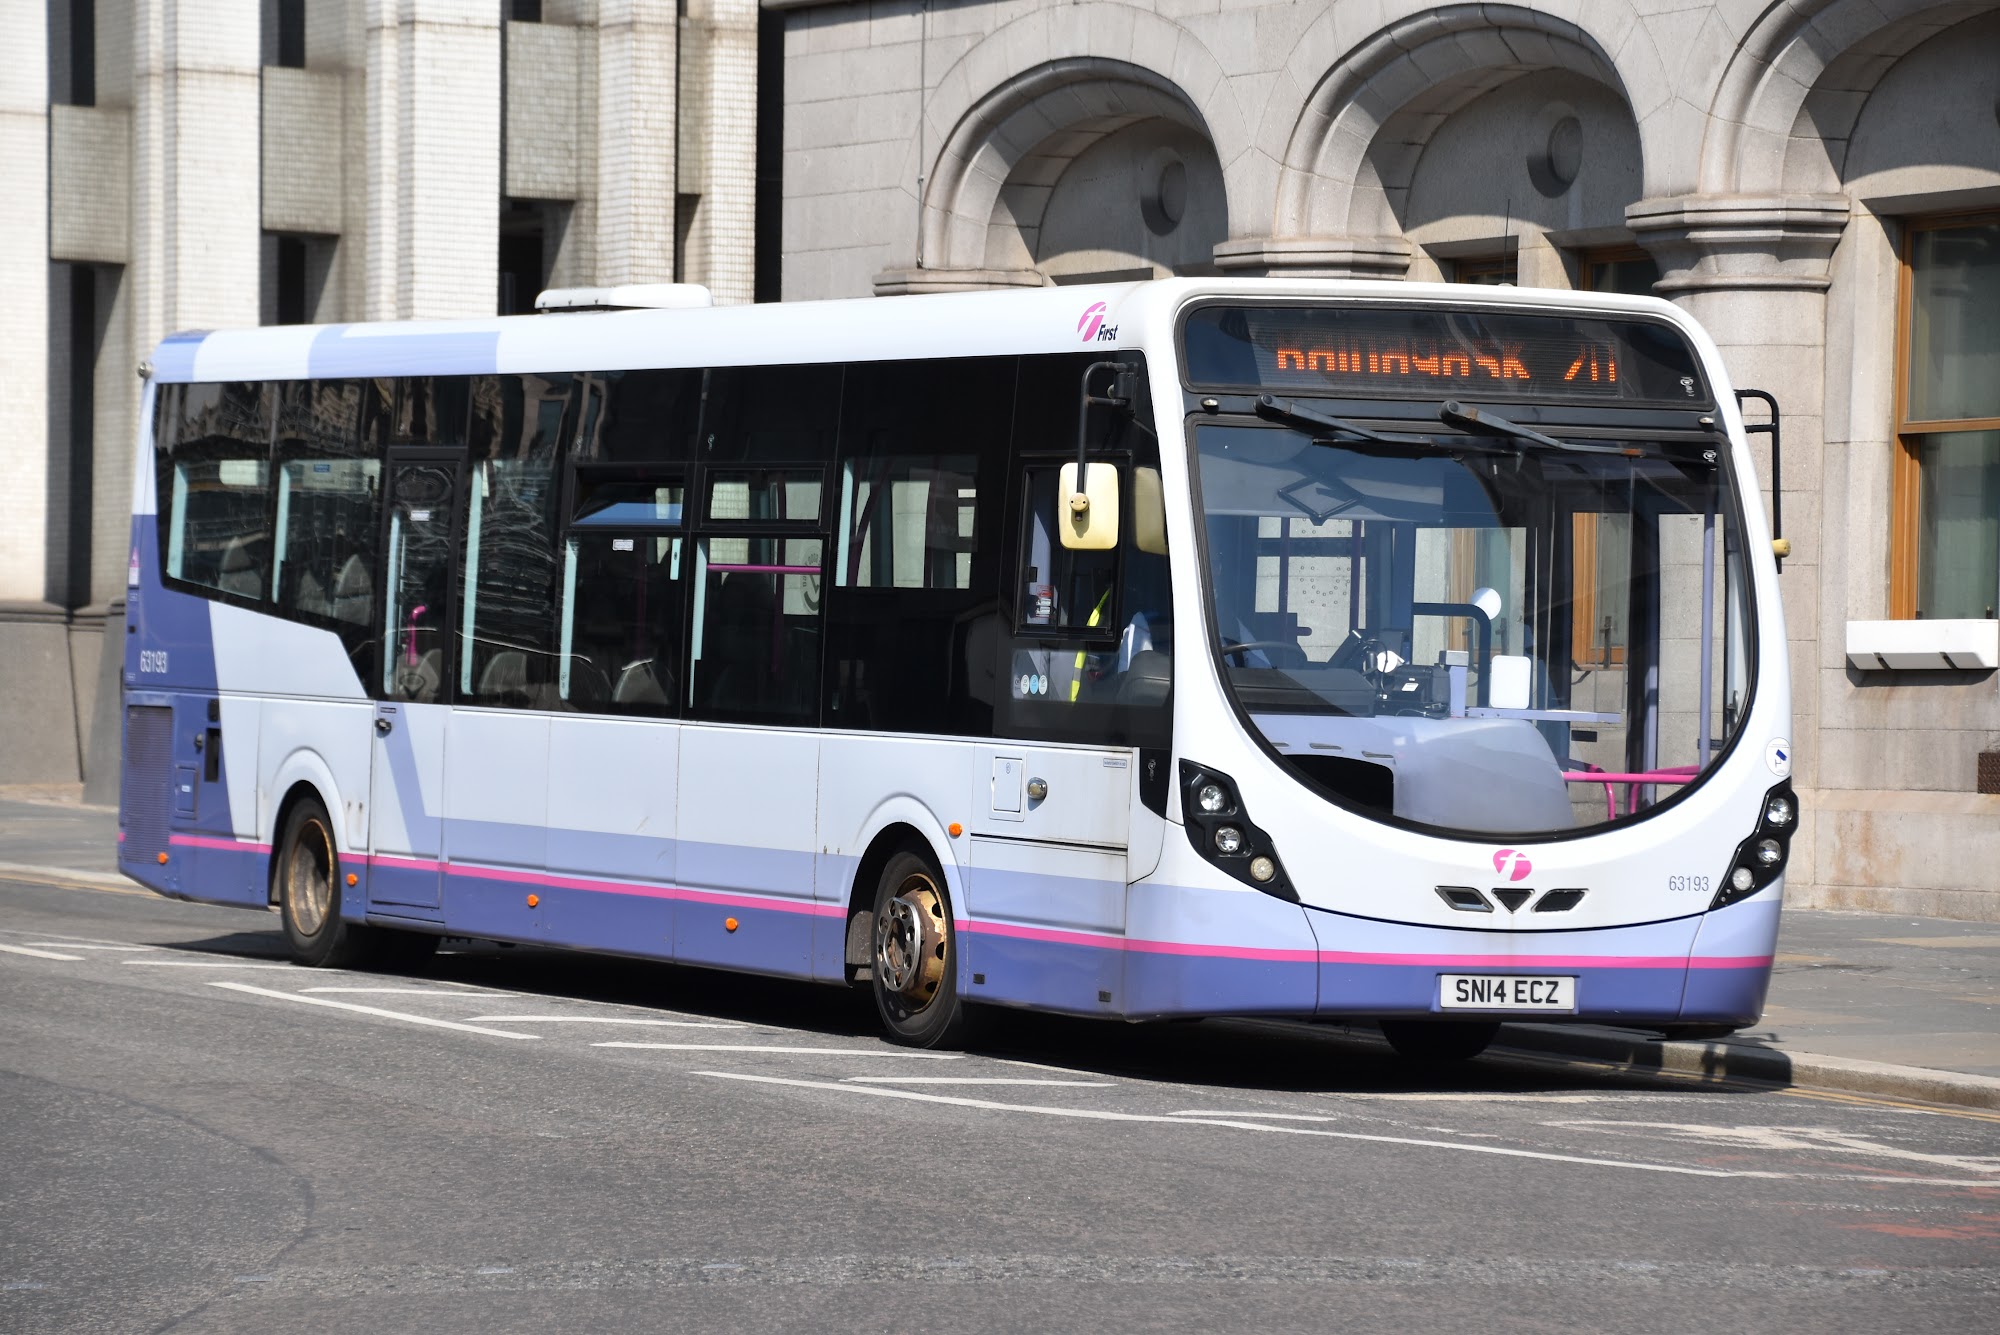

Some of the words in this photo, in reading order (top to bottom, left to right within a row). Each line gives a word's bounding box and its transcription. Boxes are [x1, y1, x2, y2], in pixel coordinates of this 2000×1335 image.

[1097, 324, 1119, 342] First
[140, 650, 168, 673] 63193
[1669, 875, 1709, 891] 63193
[1456, 979, 1506, 1003] SN14
[1514, 980, 1559, 1004] ECZ
